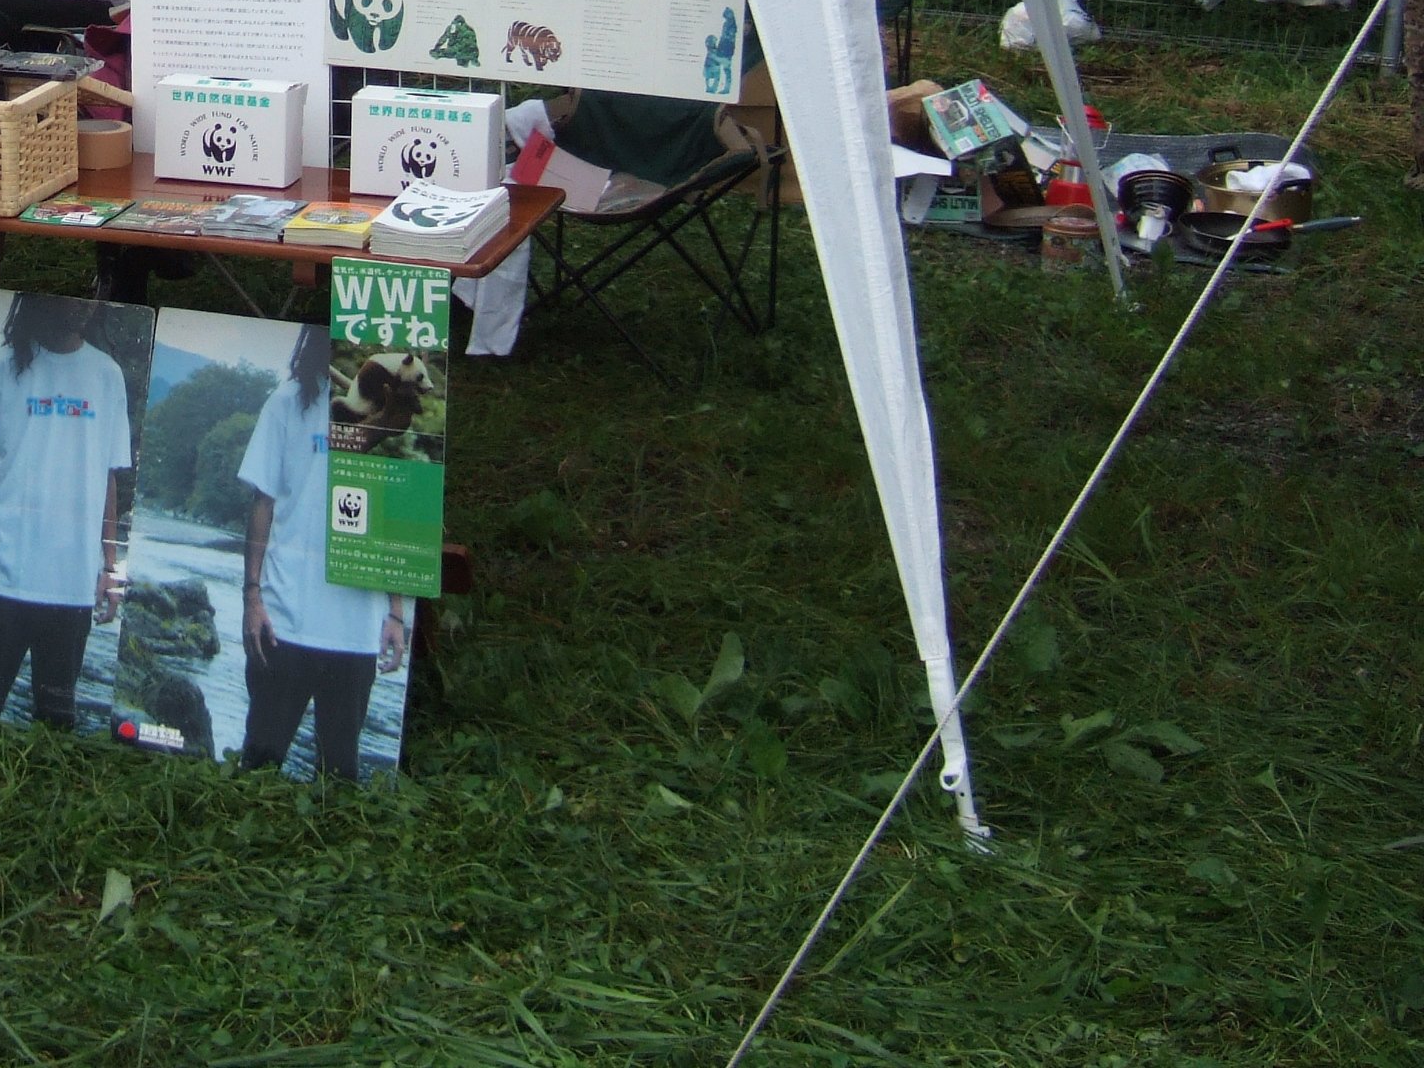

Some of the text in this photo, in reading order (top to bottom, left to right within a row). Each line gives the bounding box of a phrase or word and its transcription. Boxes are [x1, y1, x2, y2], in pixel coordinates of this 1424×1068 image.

[172, 90, 271, 108] 世界自然保護基金
[211, 111, 232, 119] FUND
[236, 117, 249, 131] FOR
[369, 104, 473, 123] 世界自然保護基金
[202, 164, 236, 177] WWF
[333, 275, 449, 313] WWF
